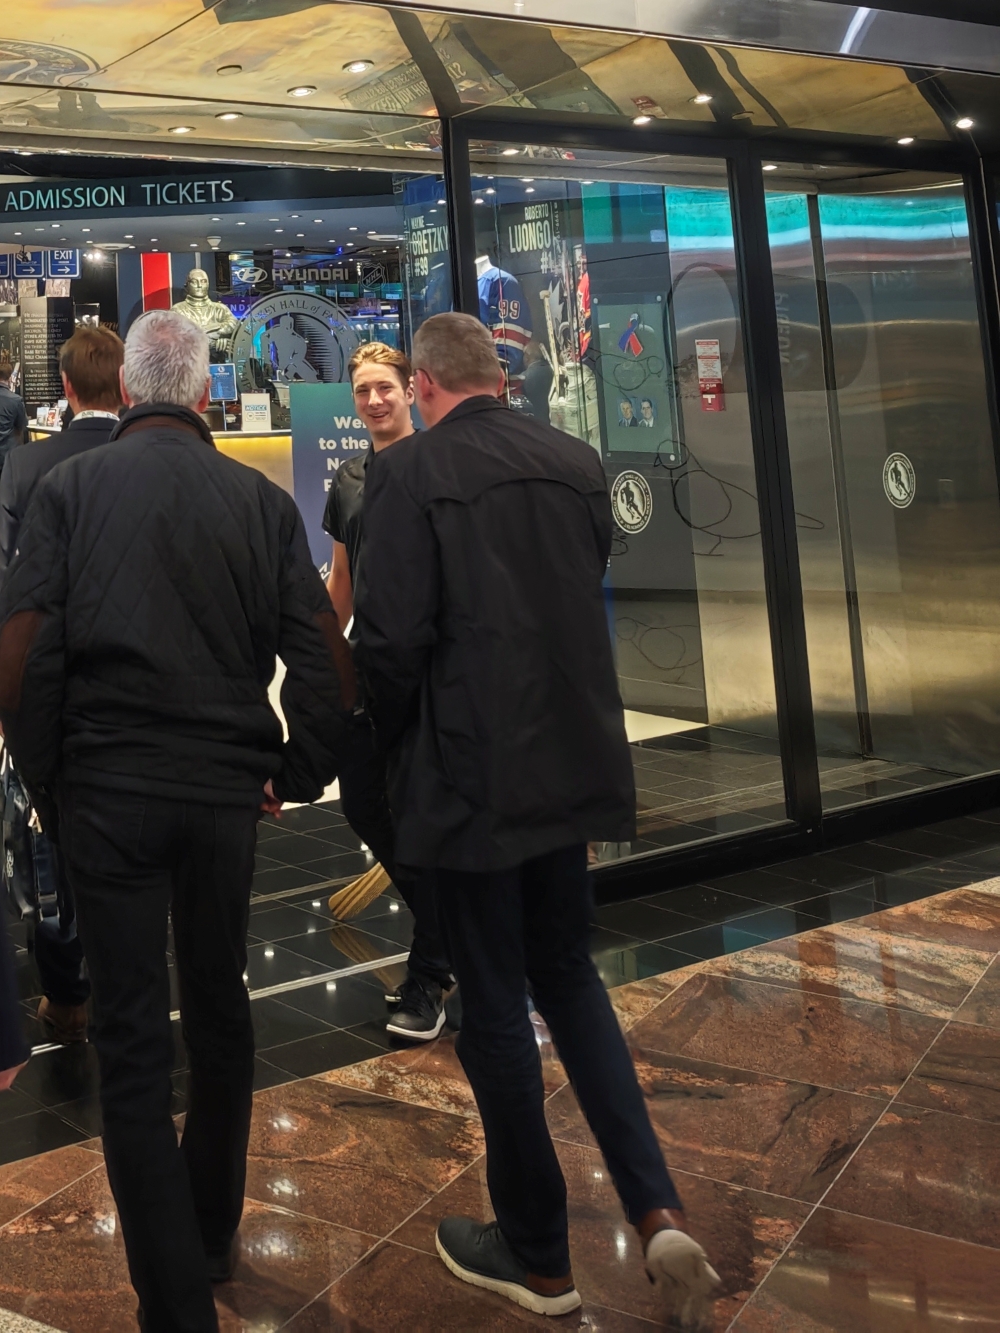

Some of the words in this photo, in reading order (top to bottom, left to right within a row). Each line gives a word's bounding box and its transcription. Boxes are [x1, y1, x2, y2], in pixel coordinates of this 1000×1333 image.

[4, 185, 125, 211] ADMISSION
[141, 179, 234, 206] TICKETS
[524, 203, 549, 220] ROBERTO
[412, 225, 449, 256] GRETZKY
[508, 219, 550, 253] LUONGO
[54, 250, 73, 260] EXIT
[414, 256, 429, 276] #99
[272, 268, 349, 282] HYUNDAI
[365, 270, 381, 285] NHL
[279, 298, 308, 311] HALL
[310, 305, 321, 315] of
[499, 299, 521, 319] 99
[319, 437, 337, 450] to
[341, 436, 369, 450] the
